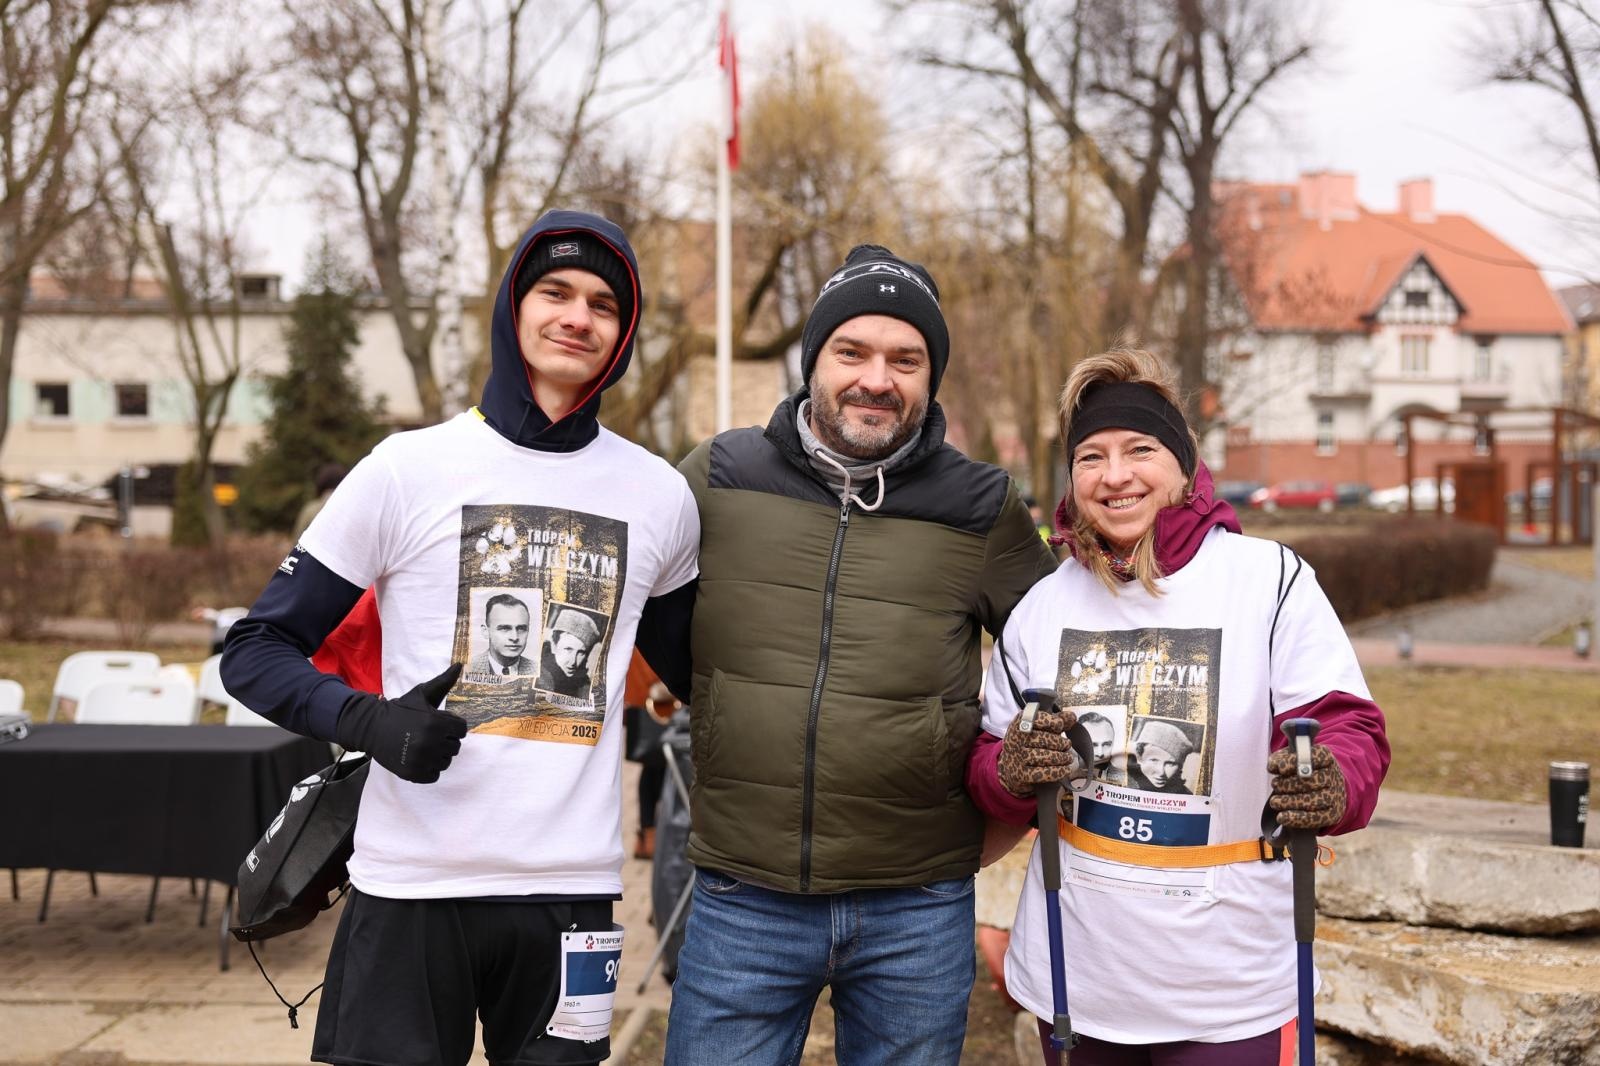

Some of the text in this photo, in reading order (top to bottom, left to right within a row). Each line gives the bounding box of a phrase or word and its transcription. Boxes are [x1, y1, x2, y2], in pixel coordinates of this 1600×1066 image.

[527, 529, 576, 546] TROPEM
[527, 544, 618, 578] WILCZYM
[1117, 650, 1160, 664] TROPEM
[1116, 665, 1209, 686] WILCZYM
[534, 721, 570, 736] EDYCJA
[572, 725, 597, 738] 2025
[1106, 790, 1187, 807] TROPEM WILCZYM
[1118, 816, 1153, 842] 85
